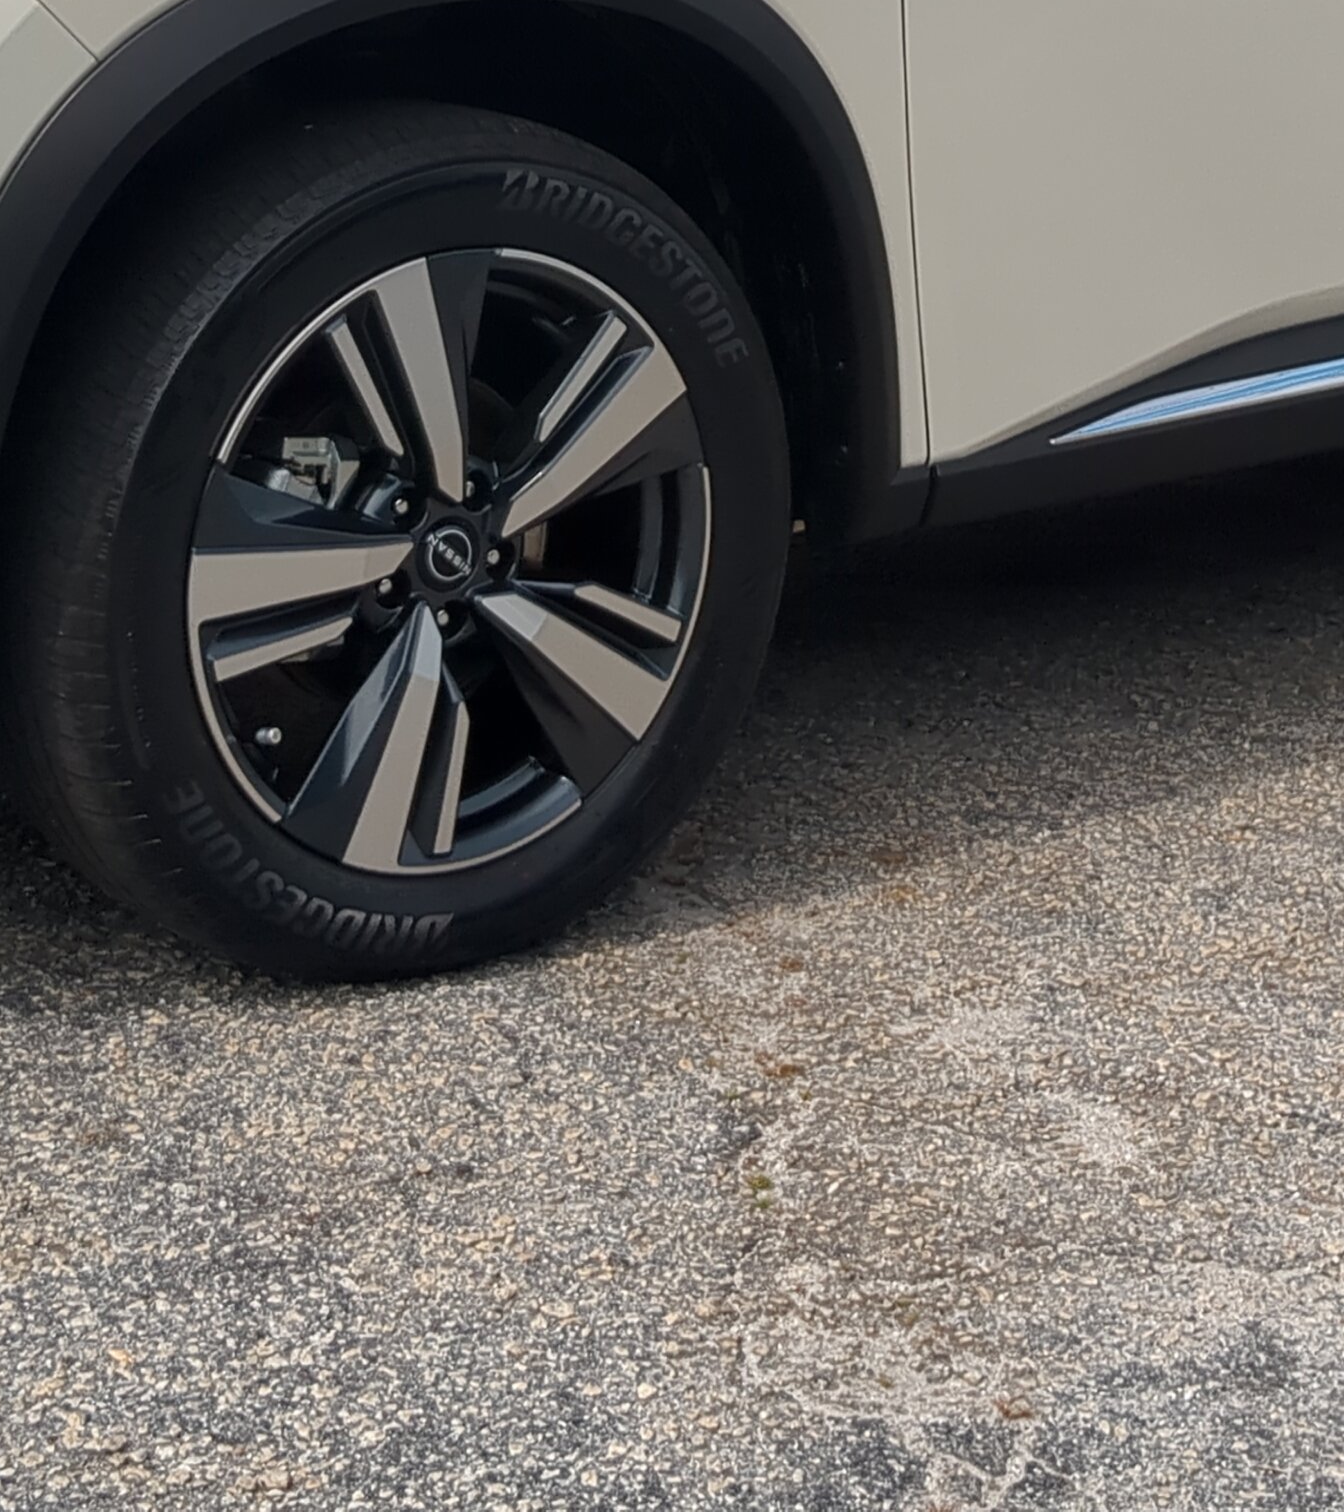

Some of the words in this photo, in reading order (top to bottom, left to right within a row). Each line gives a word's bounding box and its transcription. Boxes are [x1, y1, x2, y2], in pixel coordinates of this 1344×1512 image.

[499, 168, 750, 368] BRIDGESTONE
[426, 532, 472, 577] NISSAN
[164, 780, 455, 953] BRIDGESTONE
